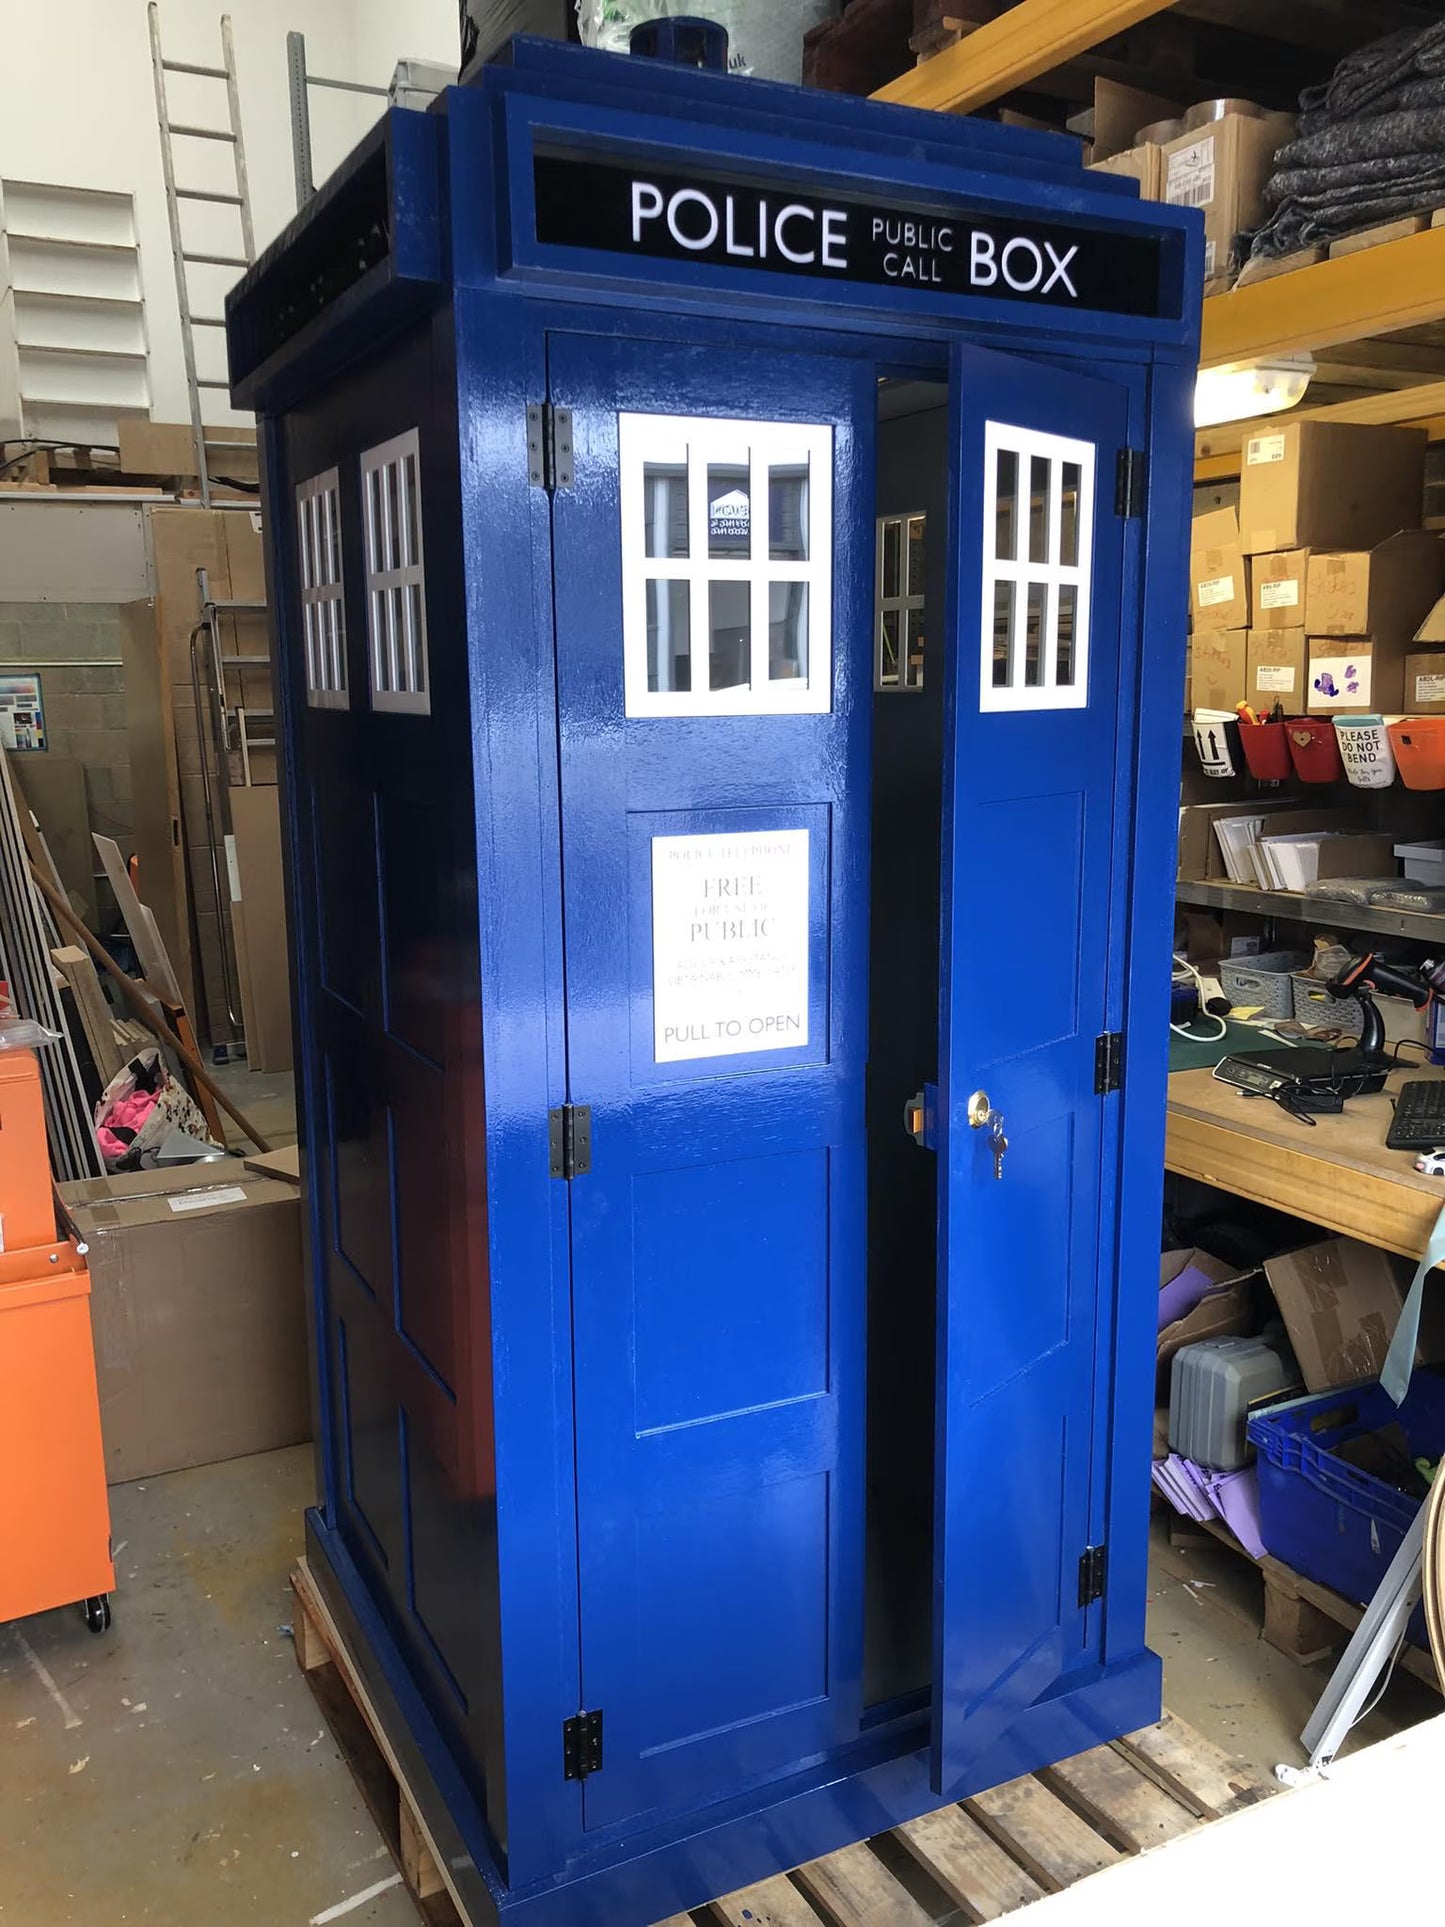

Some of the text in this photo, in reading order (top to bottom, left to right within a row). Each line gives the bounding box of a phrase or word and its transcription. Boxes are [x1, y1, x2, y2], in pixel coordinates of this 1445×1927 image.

[631, 181, 848, 269] POLICE
[871, 218, 953, 252] PUBLIC
[882, 253, 942, 283] CALL
[970, 231, 1080, 298] BOX
[1340, 729, 1379, 742] PLEASE
[1342, 740, 1381, 752] DO NOT
[1347, 753, 1377, 764] BEND
[704, 875, 764, 899] FREE
[690, 917, 776, 943] PUBLIC
[664, 1014, 801, 1044] PULL TO OPEN
